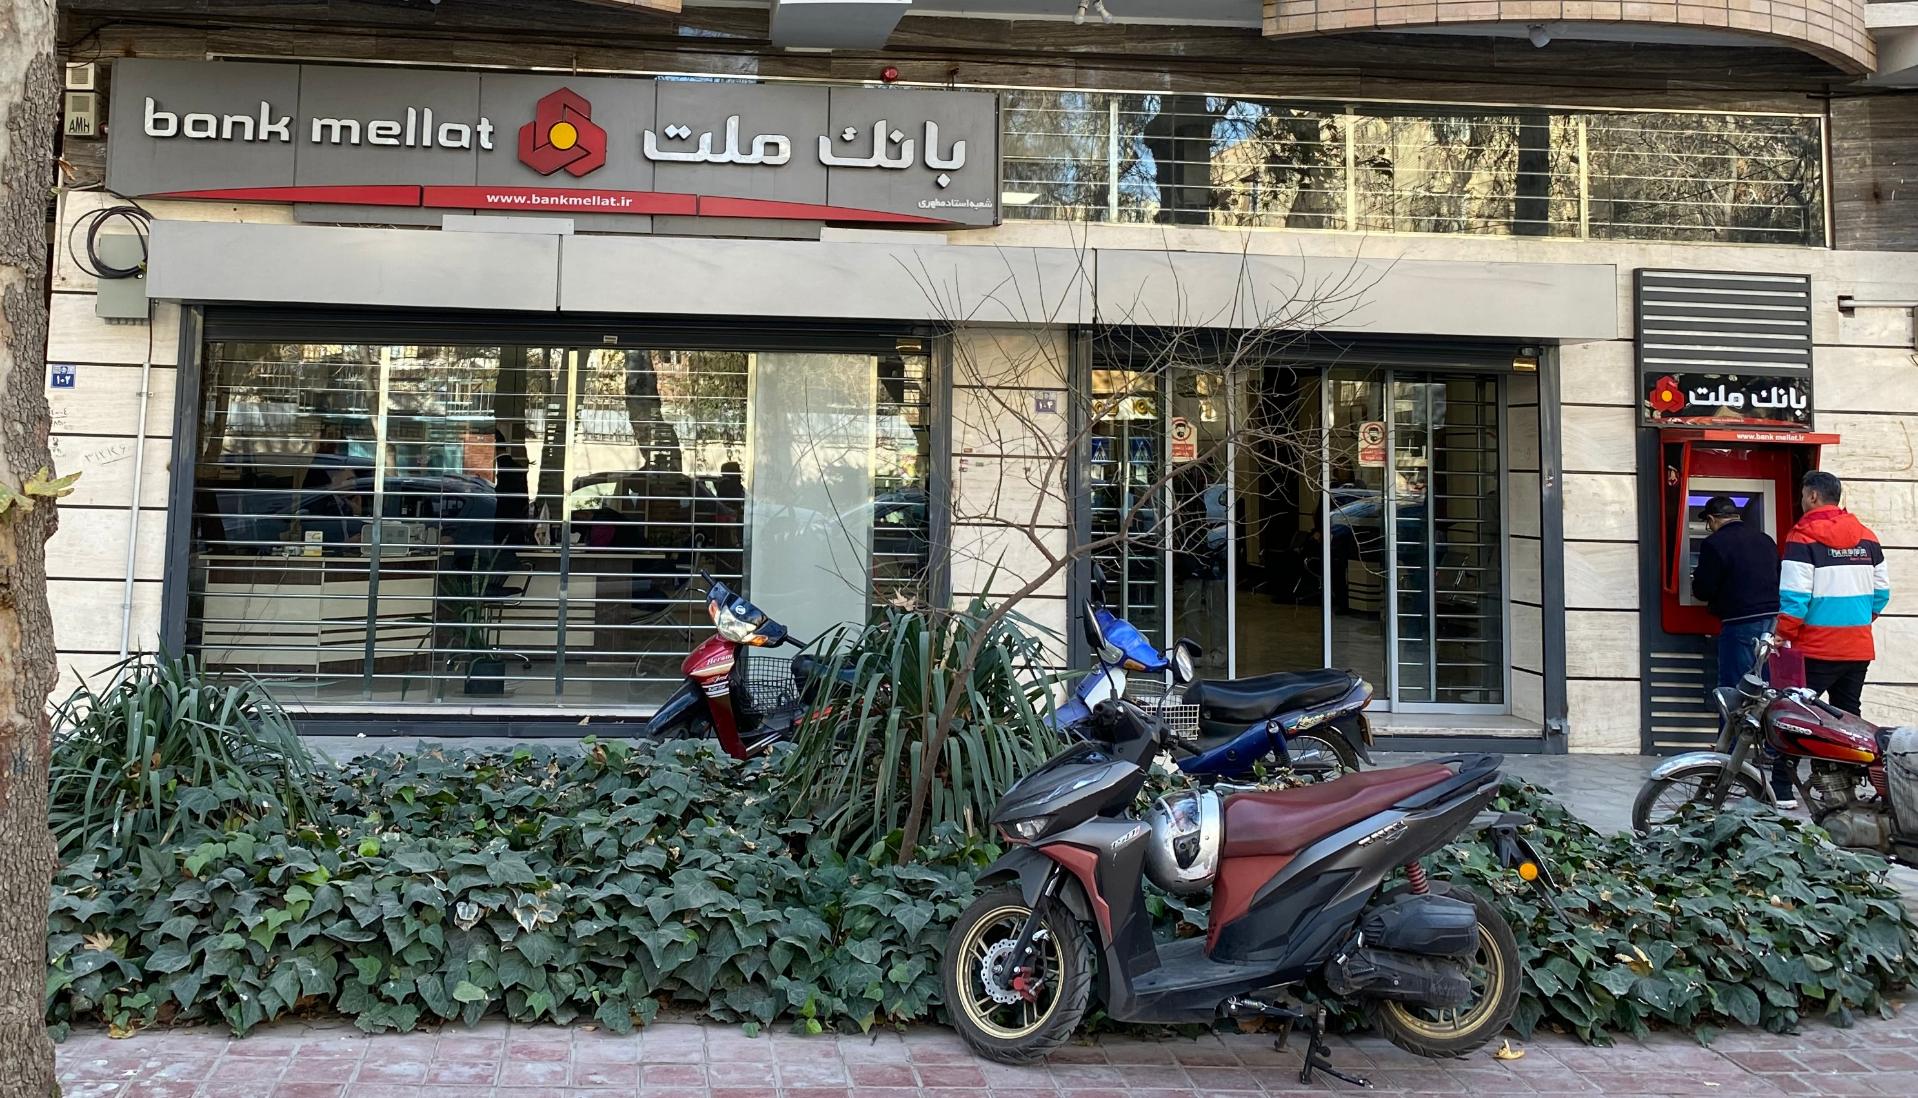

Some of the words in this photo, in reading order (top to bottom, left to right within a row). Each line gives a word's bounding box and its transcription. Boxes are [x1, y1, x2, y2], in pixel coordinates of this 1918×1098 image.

[144, 96, 293, 143] bank
[311, 106, 494, 150] mellat
[643, 115, 792, 166] ملت
[486, 194, 633, 207] www.bankmellat.ir
[1688, 384, 1745, 406] ملت
